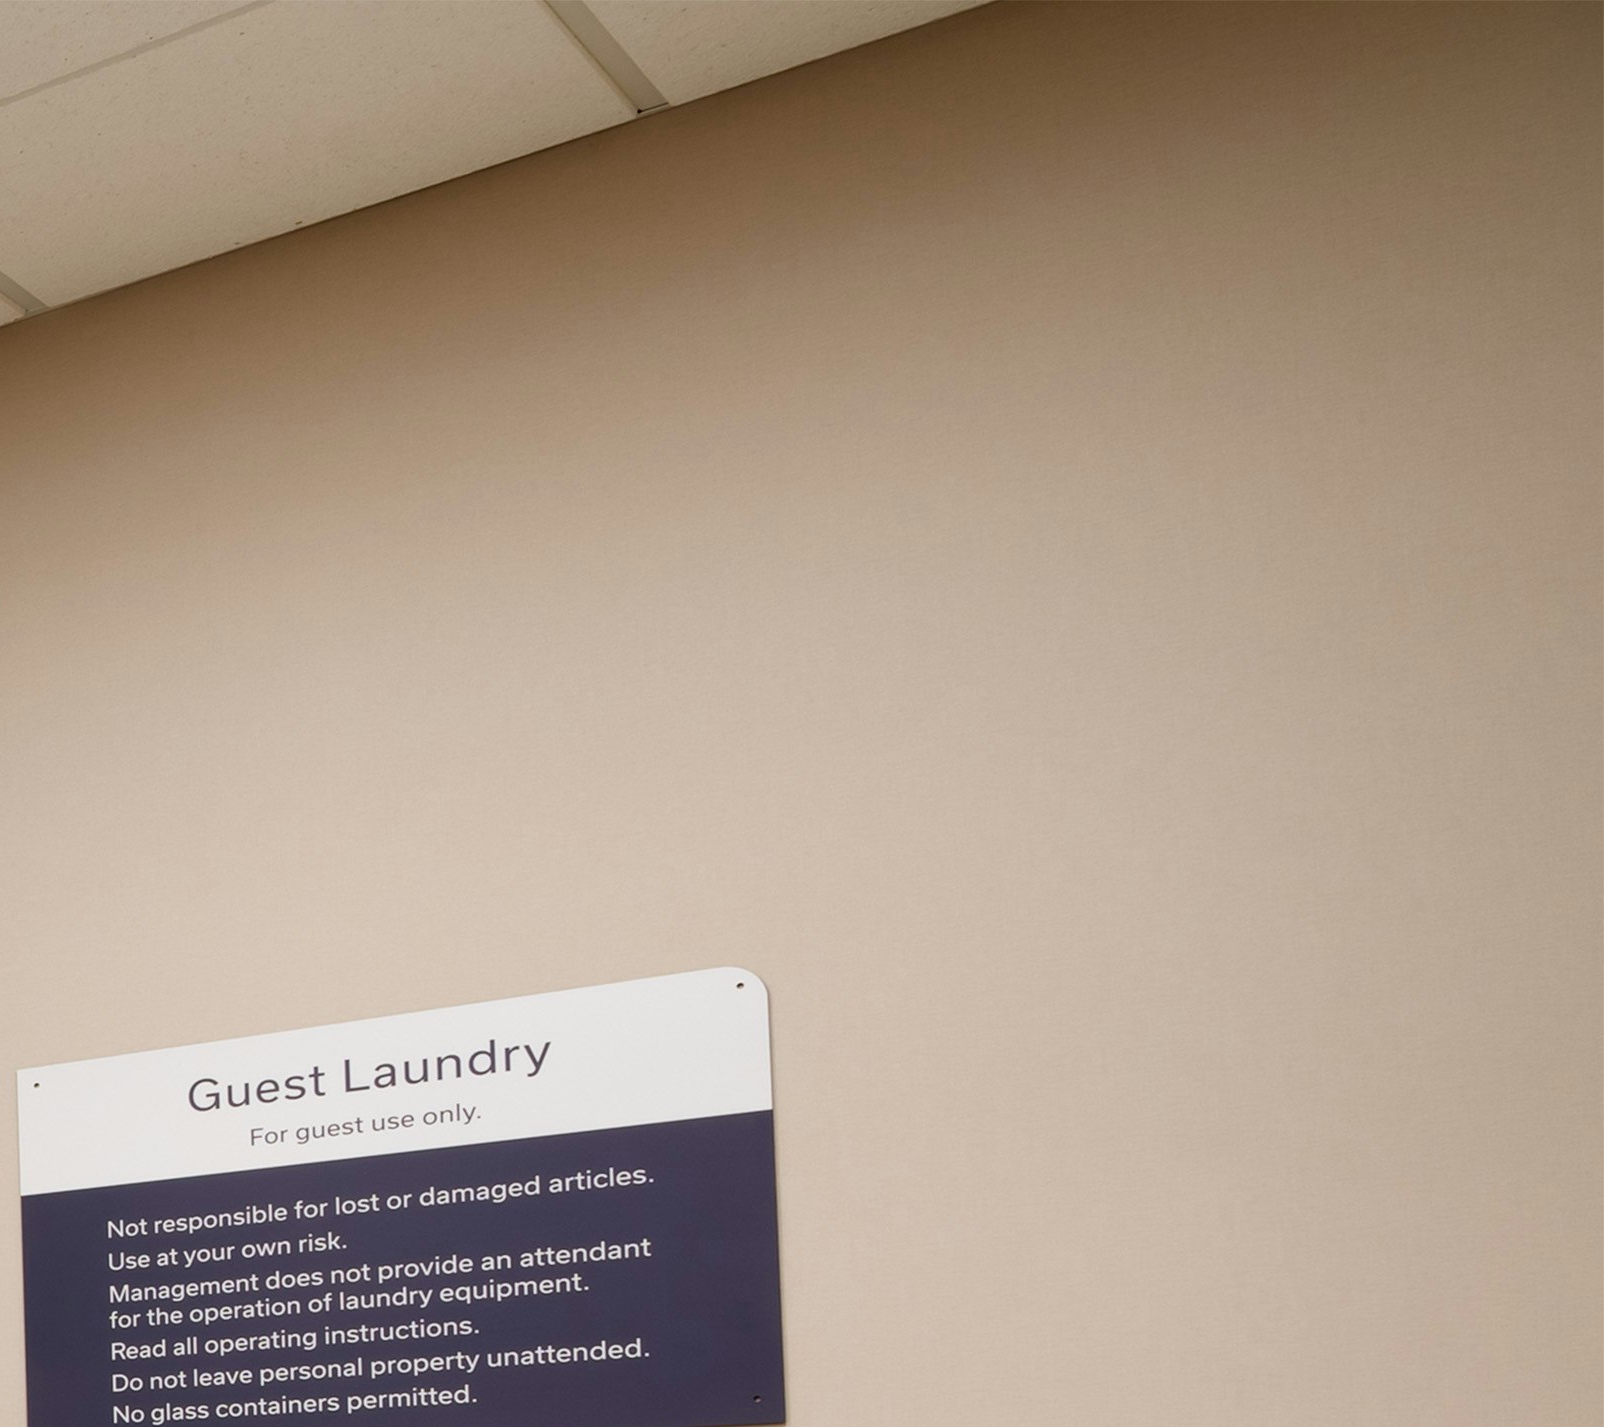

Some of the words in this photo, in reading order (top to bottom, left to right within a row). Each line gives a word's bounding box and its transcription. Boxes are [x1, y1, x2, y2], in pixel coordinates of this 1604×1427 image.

[188, 1065, 326, 1112] Guest
[344, 1039, 551, 1093] Laundry
[250, 1127, 288, 1146] For
[296, 1117, 363, 1144] guest
[372, 1112, 414, 1132] use
[423, 1103, 481, 1125] only.
[107, 1218, 148, 1239] Not
[154, 1204, 288, 1234] responsible
[294, 1200, 328, 1219] for
[335, 1193, 380, 1215] lost
[386, 1193, 412, 1210] or
[419, 1175, 541, 1207] damaged
[548, 1167, 654, 1194] articles.
[108, 1252, 150, 1272] Use
[156, 1248, 178, 1267] at
[183, 1245, 235, 1268] your
[241, 1240, 291, 1259] own
[298, 1231, 347, 1253] risk.
[109, 1273, 259, 1304] Management
[265, 1270, 324, 1290] does
[330, 1263, 371, 1285] not
[378, 1254, 473, 1284] provide
[480, 1254, 511, 1272] an
[520, 1238, 652, 1268] attendant
[109, 1310, 141, 1329] for
[146, 1306, 183, 1327] the
[189, 1298, 301, 1325] operation
[308, 1293, 333, 1313] of
[339, 1286, 433, 1310] laundry
[439, 1273, 589, 1304] equipment.
[111, 1339, 167, 1361] Read
[173, 1336, 198, 1356] all
[204, 1329, 317, 1357] operating
[324, 1318, 480, 1346] instructions.
[112, 1373, 143, 1393] Do
[149, 1370, 188, 1390] not
[193, 1368, 253, 1387] leave
[259, 1357, 363, 1387] personal
[370, 1351, 480, 1379] property
[487, 1337, 650, 1368] unattended.
[113, 1405, 145, 1424] No
[150, 1402, 210, 1426] glass
[215, 1395, 339, 1418] containers
[347, 1384, 478, 1414] permitted.
